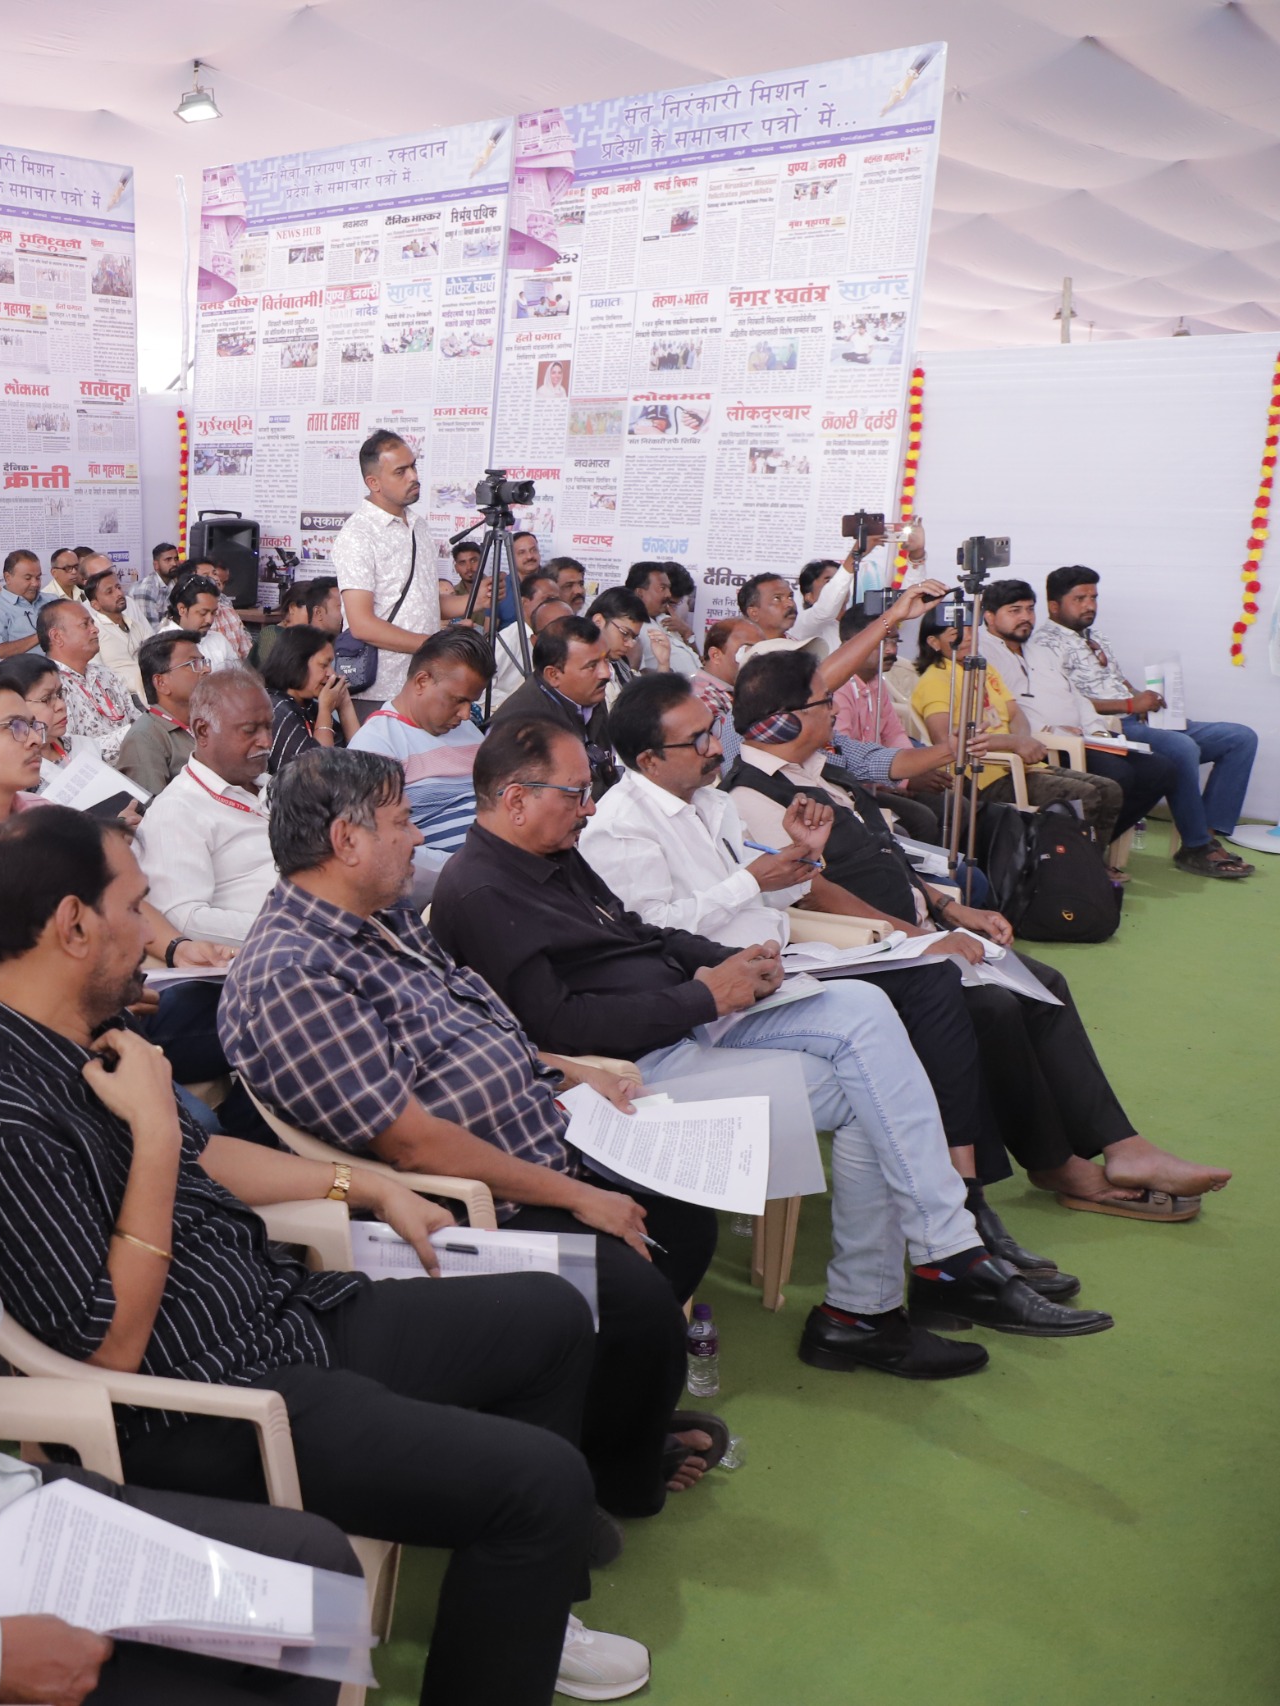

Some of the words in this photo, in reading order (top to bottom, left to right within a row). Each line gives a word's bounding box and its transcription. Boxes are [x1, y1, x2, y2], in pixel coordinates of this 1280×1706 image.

[624, 103, 654, 125] संत
[661, 84, 741, 120] निरंकारी
[750, 79, 809, 106] मिशन
[601, 135, 643, 161] प्रदेश
[651, 128, 667, 152] के
[675, 121, 753, 149] समाचार
[761, 107, 808, 136] पत्रों
[22, 155, 55, 179] मिशन
[304, 159, 345, 177] नारायण
[350, 155, 372, 174] पूजा
[387, 140, 448, 164] रक्तदान
[787, 162, 808, 177] पुण्य
[817, 152, 847, 170] नगरी
[9, 182, 57, 204] समाचार
[60, 187, 87, 207] पत्रों
[285, 184, 310, 201] प्रदेश
[314, 181, 323, 196] के
[327, 178, 370, 195] समाचार
[375, 170, 399, 188] पत्रों
[591, 186, 609, 200] पुण्य
[617, 179, 641, 194] नगरी
[342, 219, 368, 230] नवभारत
[385, 214, 410, 227] दैनिक
[411, 211, 442, 225] भास्कर
[276, 229, 301, 241] NEWS
[303, 226, 321, 237] HUB
[353, 281, 380, 299] नगरी
[387, 282, 433, 303] सागर
[729, 289, 771, 307] नगर
[774, 282, 830, 304] स्वतंत्र
[838, 278, 910, 301] सागर
[590, 298, 620, 309] प्रभात
[652, 295, 677, 308] तरुण
[684, 292, 709, 307] भारत
[4, 378, 50, 397] लोकमत
[632, 392, 712, 401] लोकमत
[433, 407, 457, 417] प्रजा
[458, 404, 488, 417] संवाद
[726, 401, 812, 424] लोकदरबार
[2, 462, 29, 472] दैनिक
[574, 459, 610, 469] नवभारत
[3, 464, 71, 490] क्रांती
[312, 516, 345, 529] सकाळ
[572, 534, 614, 548] नवराष्ट्र
[703, 567, 747, 586] दैनिक
